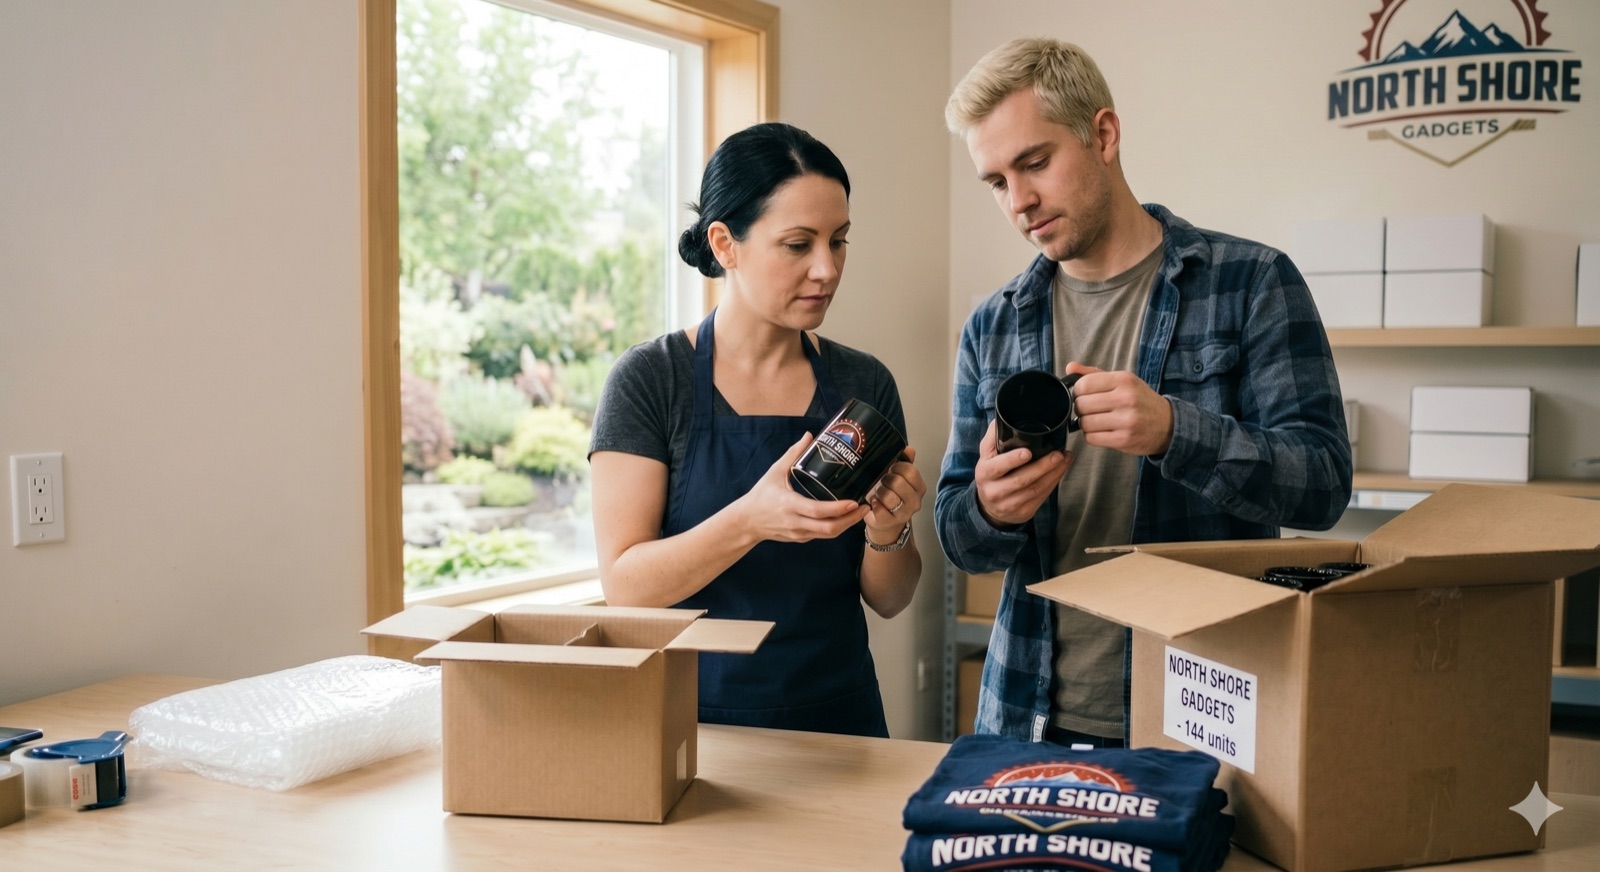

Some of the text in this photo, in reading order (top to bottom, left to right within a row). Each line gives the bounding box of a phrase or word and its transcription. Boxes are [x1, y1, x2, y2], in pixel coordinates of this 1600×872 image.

[1328, 60, 1582, 121] NORTH SHORE
[1402, 119, 1499, 139] GADGETS
[835, 442, 860, 466] SHORE
[1169, 654, 1251, 701] NORTH SHORE
[1181, 687, 1235, 724] GADGETS
[1185, 719, 1204, 742] 144
[1208, 733, 1236, 757] units
[945, 787, 1050, 805] NORTH
[1056, 788, 1160, 818] SHORE
[931, 834, 1153, 872] NORTH SHORE
